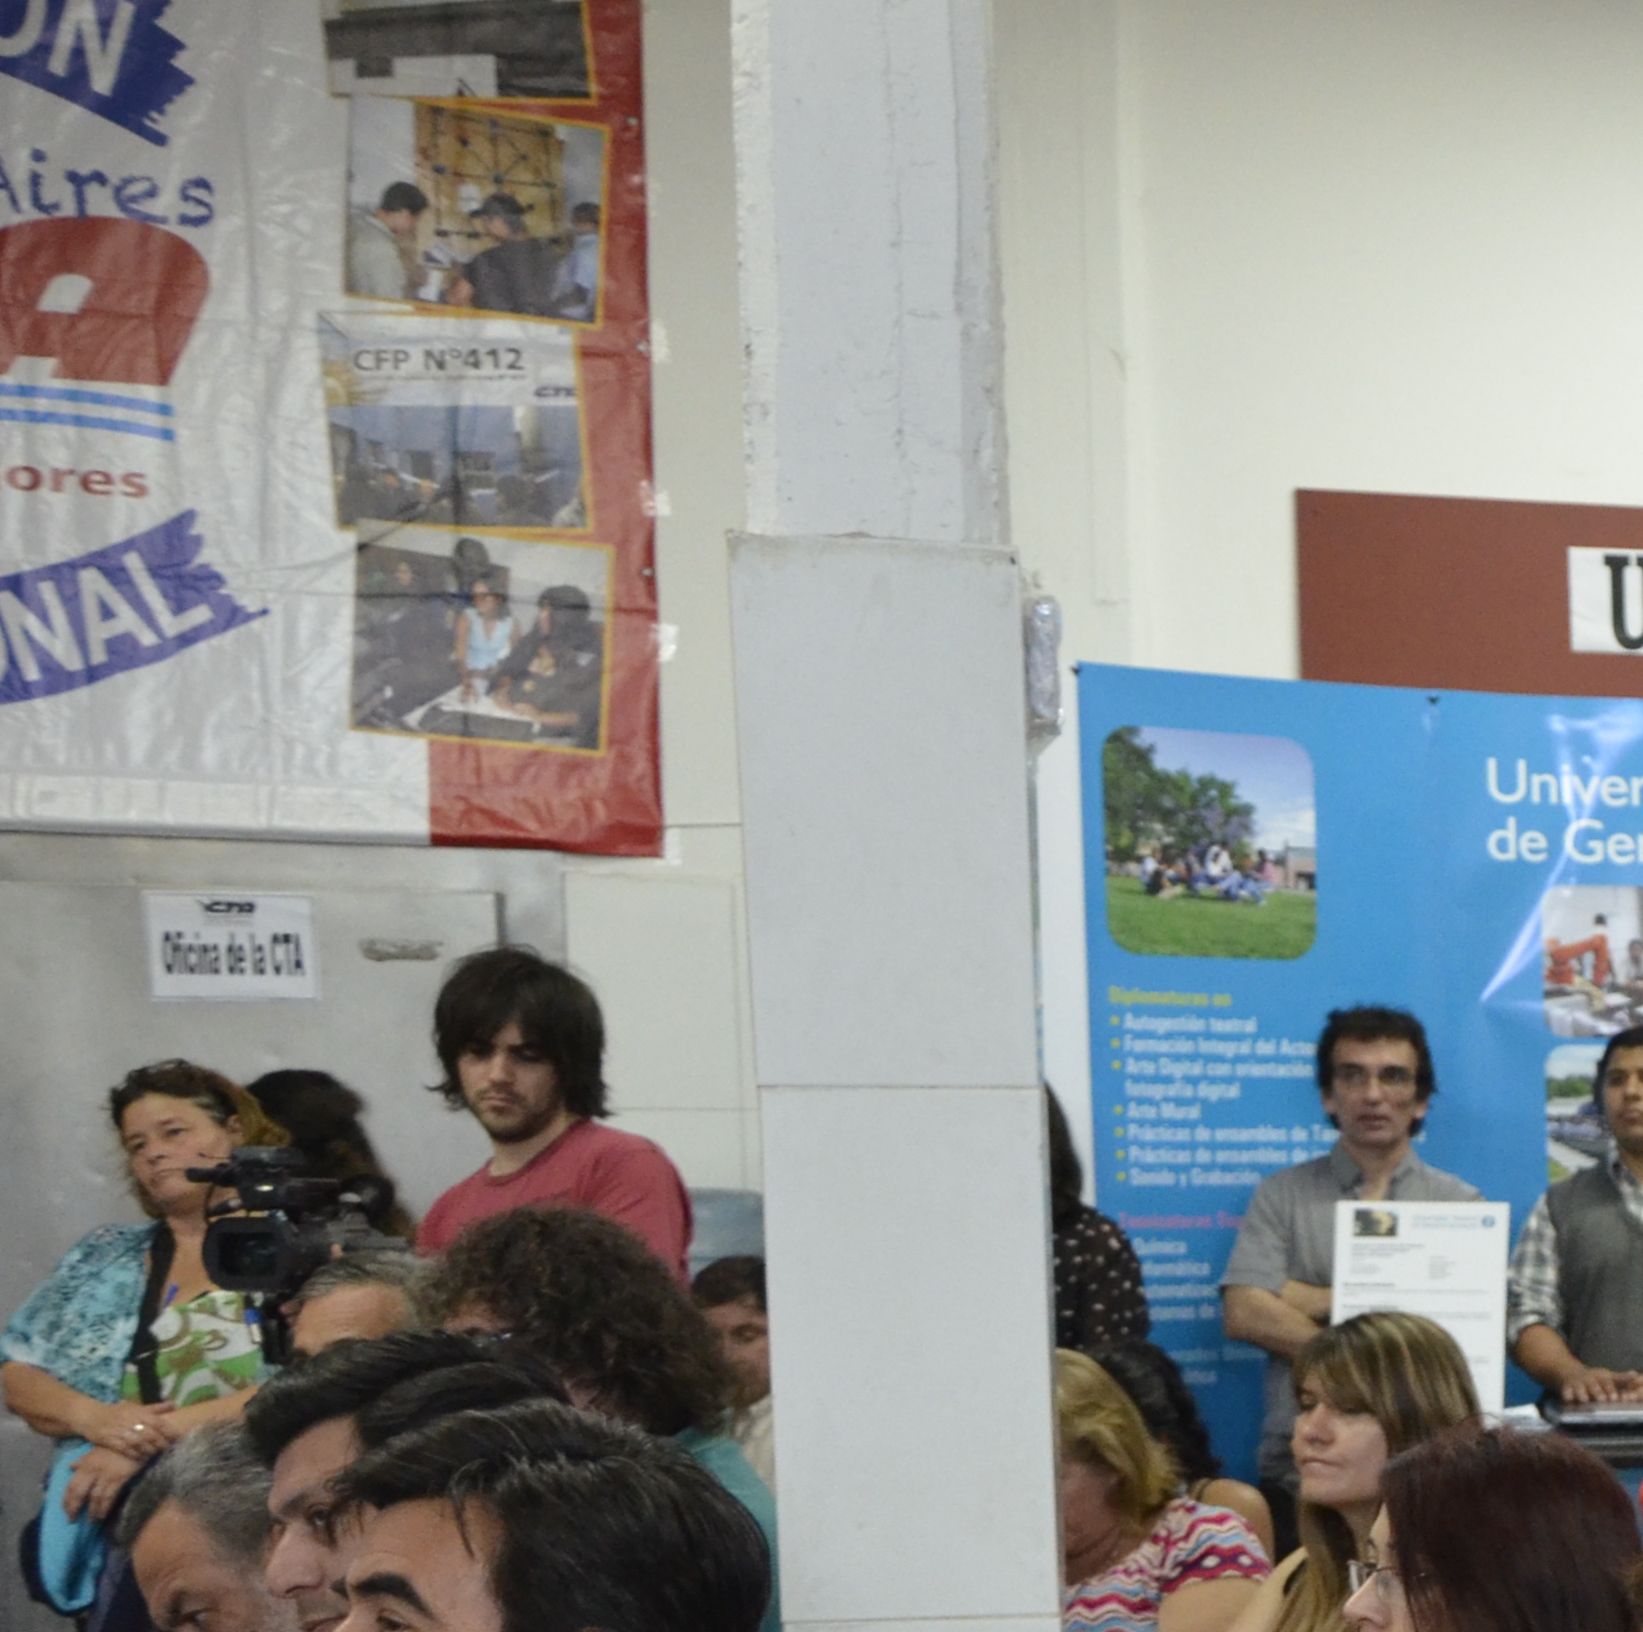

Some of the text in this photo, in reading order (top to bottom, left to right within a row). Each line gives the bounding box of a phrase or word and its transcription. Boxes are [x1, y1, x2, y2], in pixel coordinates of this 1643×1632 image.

[354, 348, 409, 371] CFP
[0, 550, 214, 683] NAL
[1487, 816, 1548, 863] de
[162, 930, 306, 976] Oficina de la CTA
